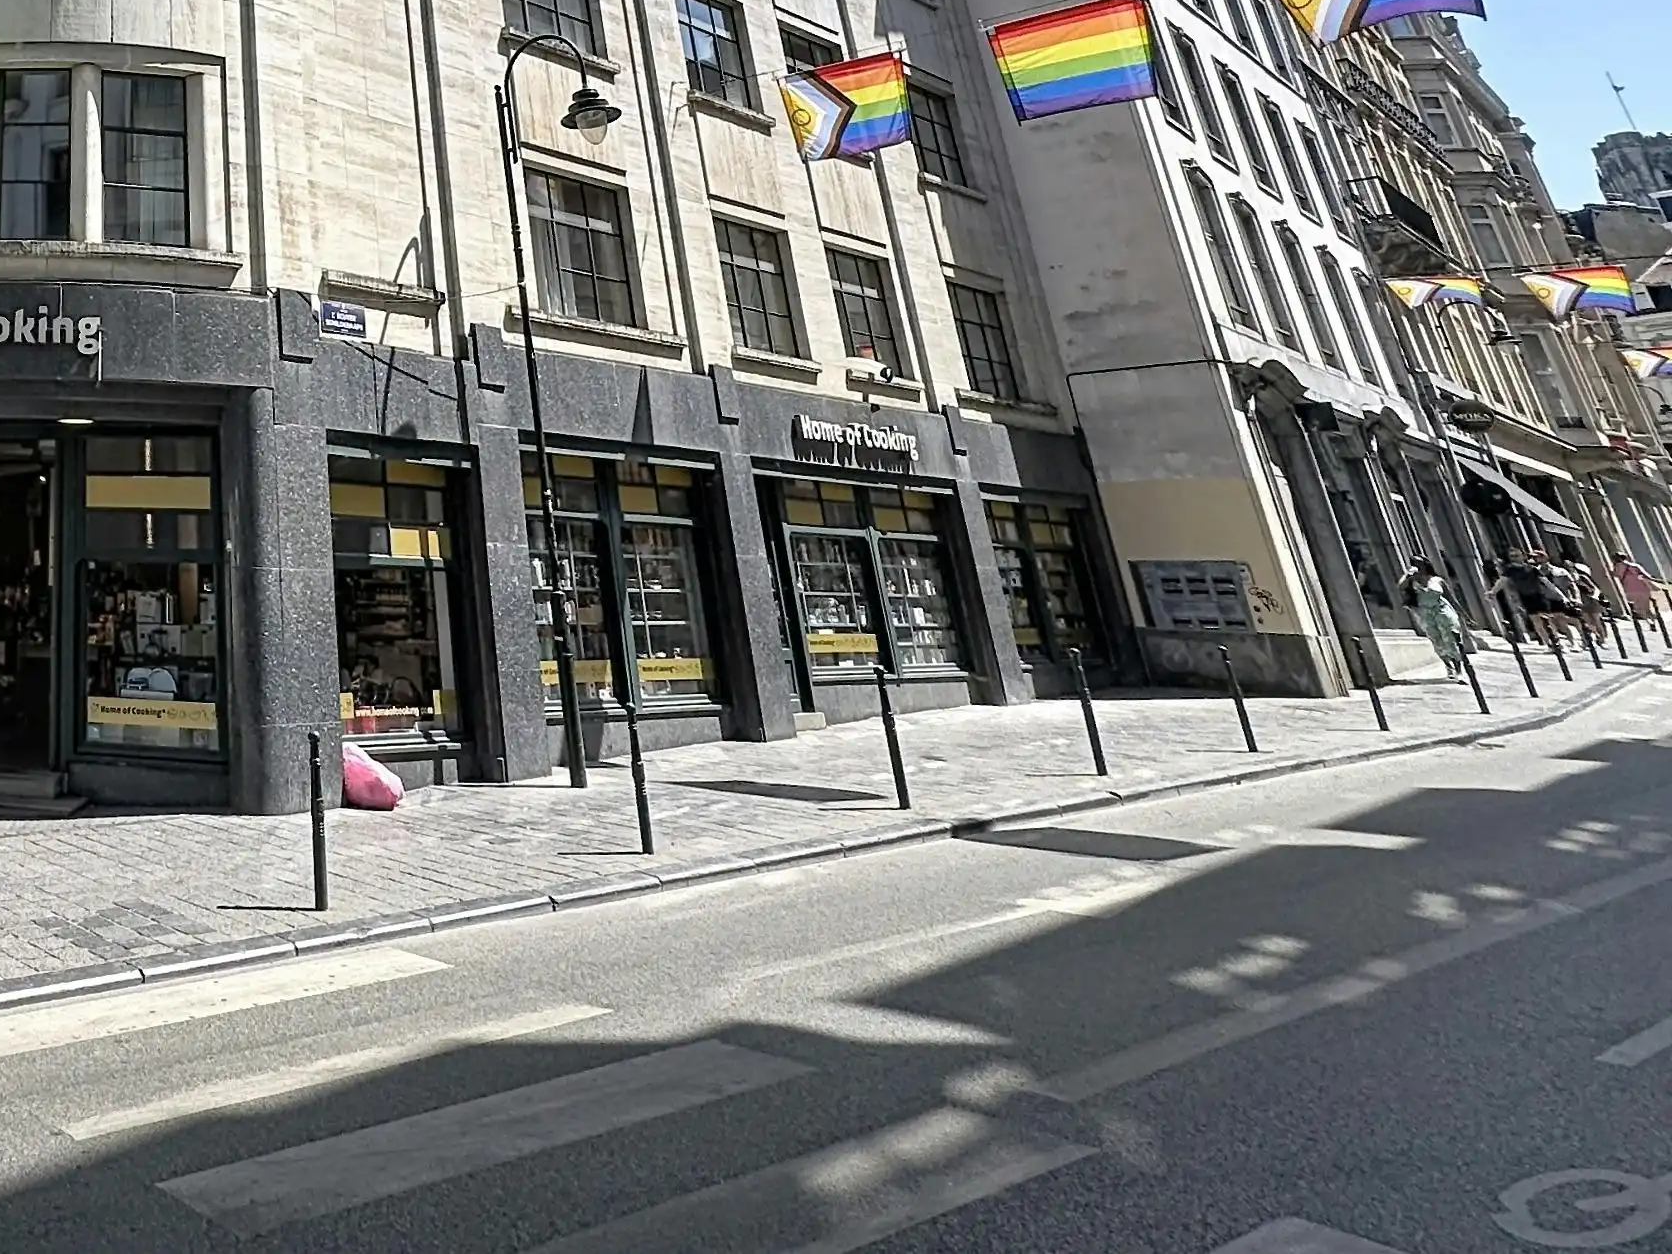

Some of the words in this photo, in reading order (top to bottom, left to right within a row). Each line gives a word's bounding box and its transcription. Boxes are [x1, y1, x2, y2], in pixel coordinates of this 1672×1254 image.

[800, 414, 844, 444] Home
[846, 422, 865, 446] of
[864, 424, 919, 461] Cooking
[100, 705, 121, 714] Home
[122, 705, 131, 715] of
